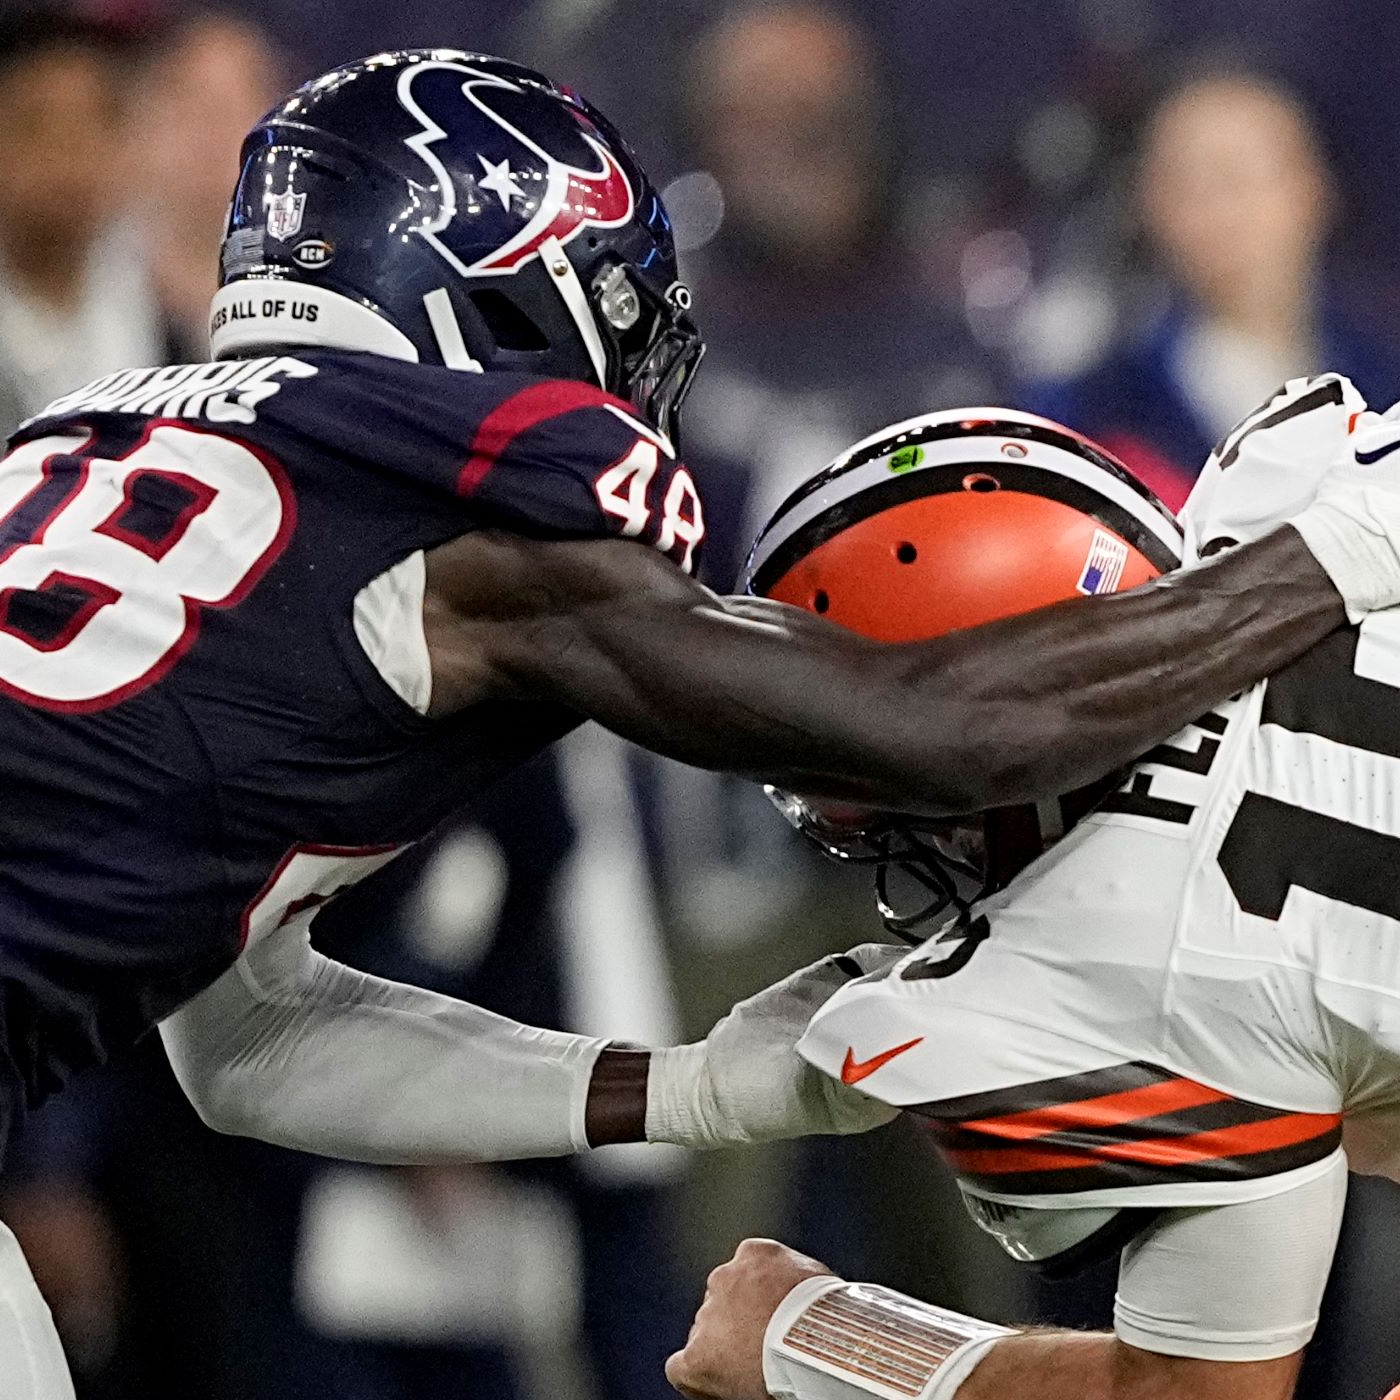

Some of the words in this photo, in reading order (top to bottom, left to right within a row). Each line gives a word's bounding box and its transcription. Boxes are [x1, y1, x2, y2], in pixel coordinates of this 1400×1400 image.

[231, 300, 256, 321] ALL
[262, 299, 286, 318] OF
[291, 300, 319, 322] US
[593, 434, 707, 577] 48
